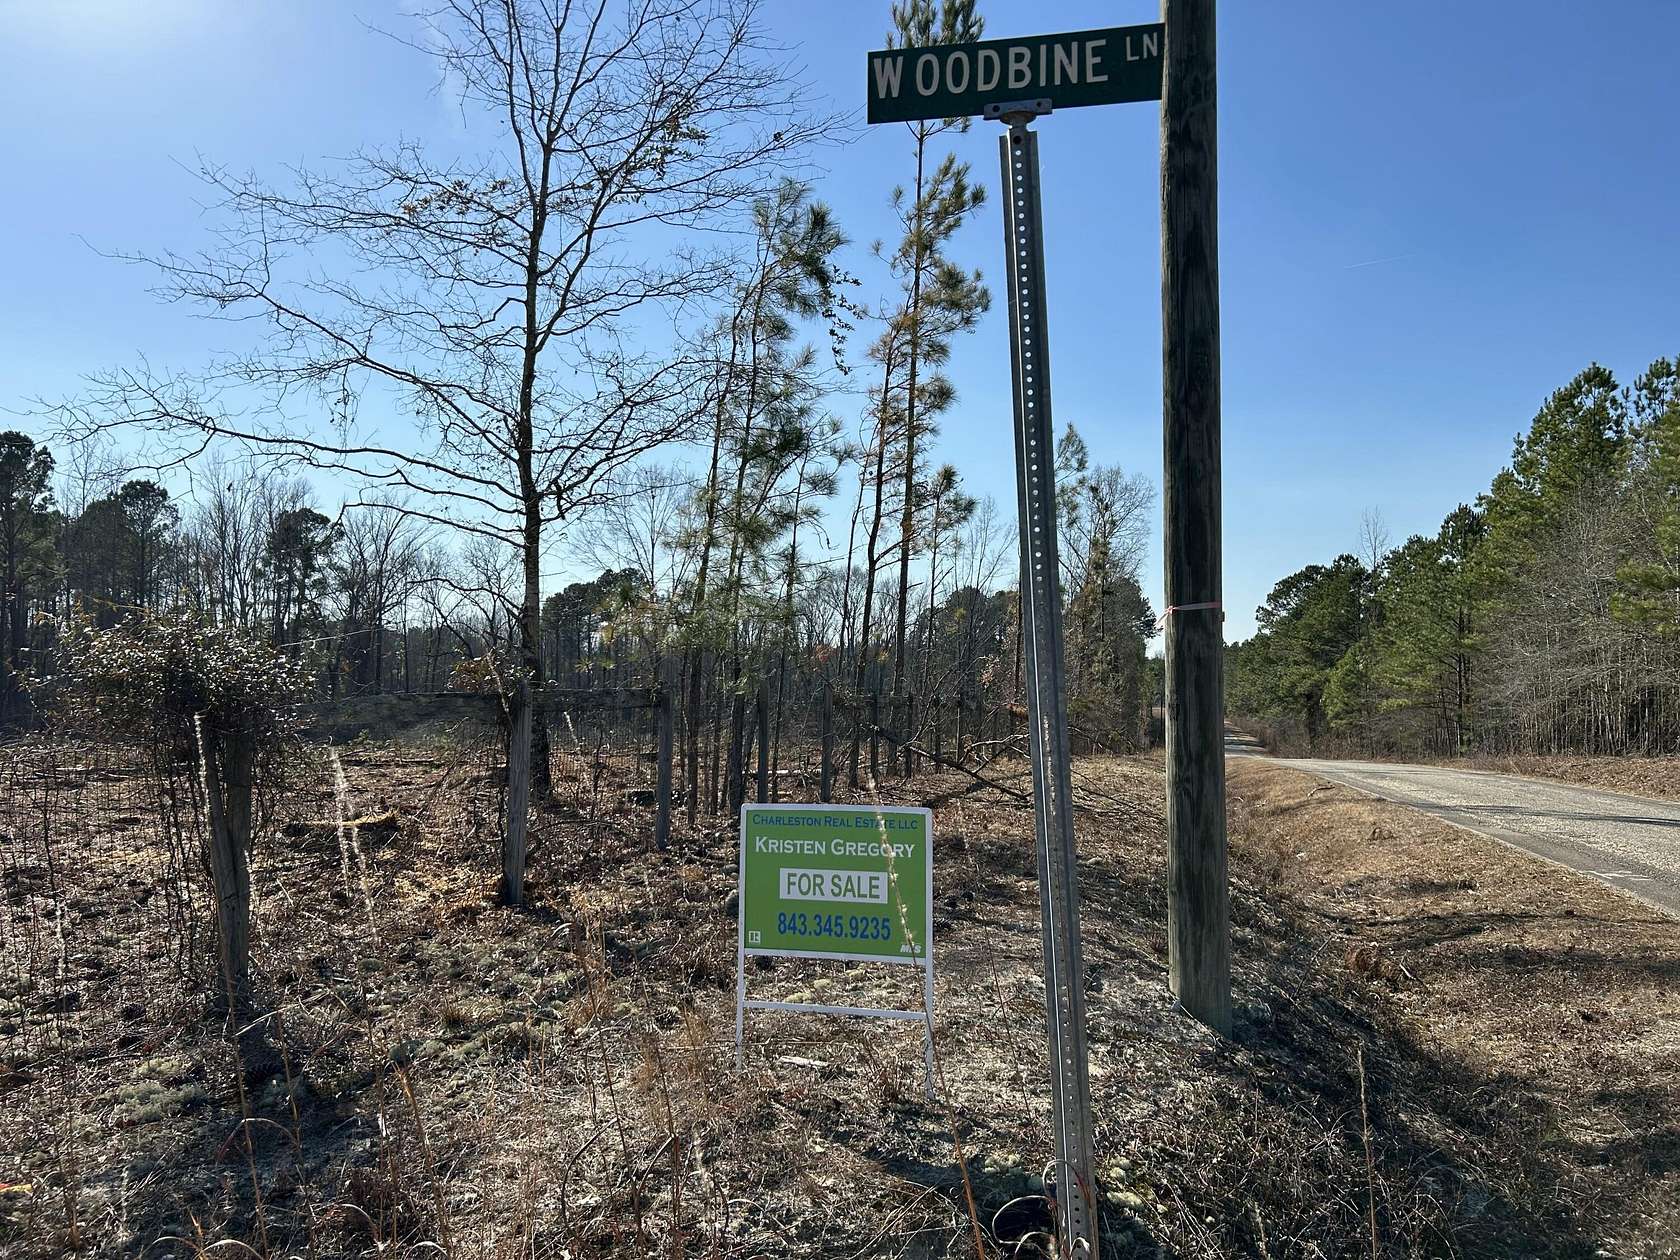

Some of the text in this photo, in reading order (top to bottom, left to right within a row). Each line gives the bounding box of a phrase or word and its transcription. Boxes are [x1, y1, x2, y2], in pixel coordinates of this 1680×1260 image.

[873, 32, 1158, 99] WOODBINE LN
[752, 814, 918, 830] CHARLESTON REAL ESTATE LLC
[755, 836, 915, 858] KRISTEN GREGORY
[787, 872, 880, 899] FOR SALE
[778, 912, 891, 941] 843.345.9235
